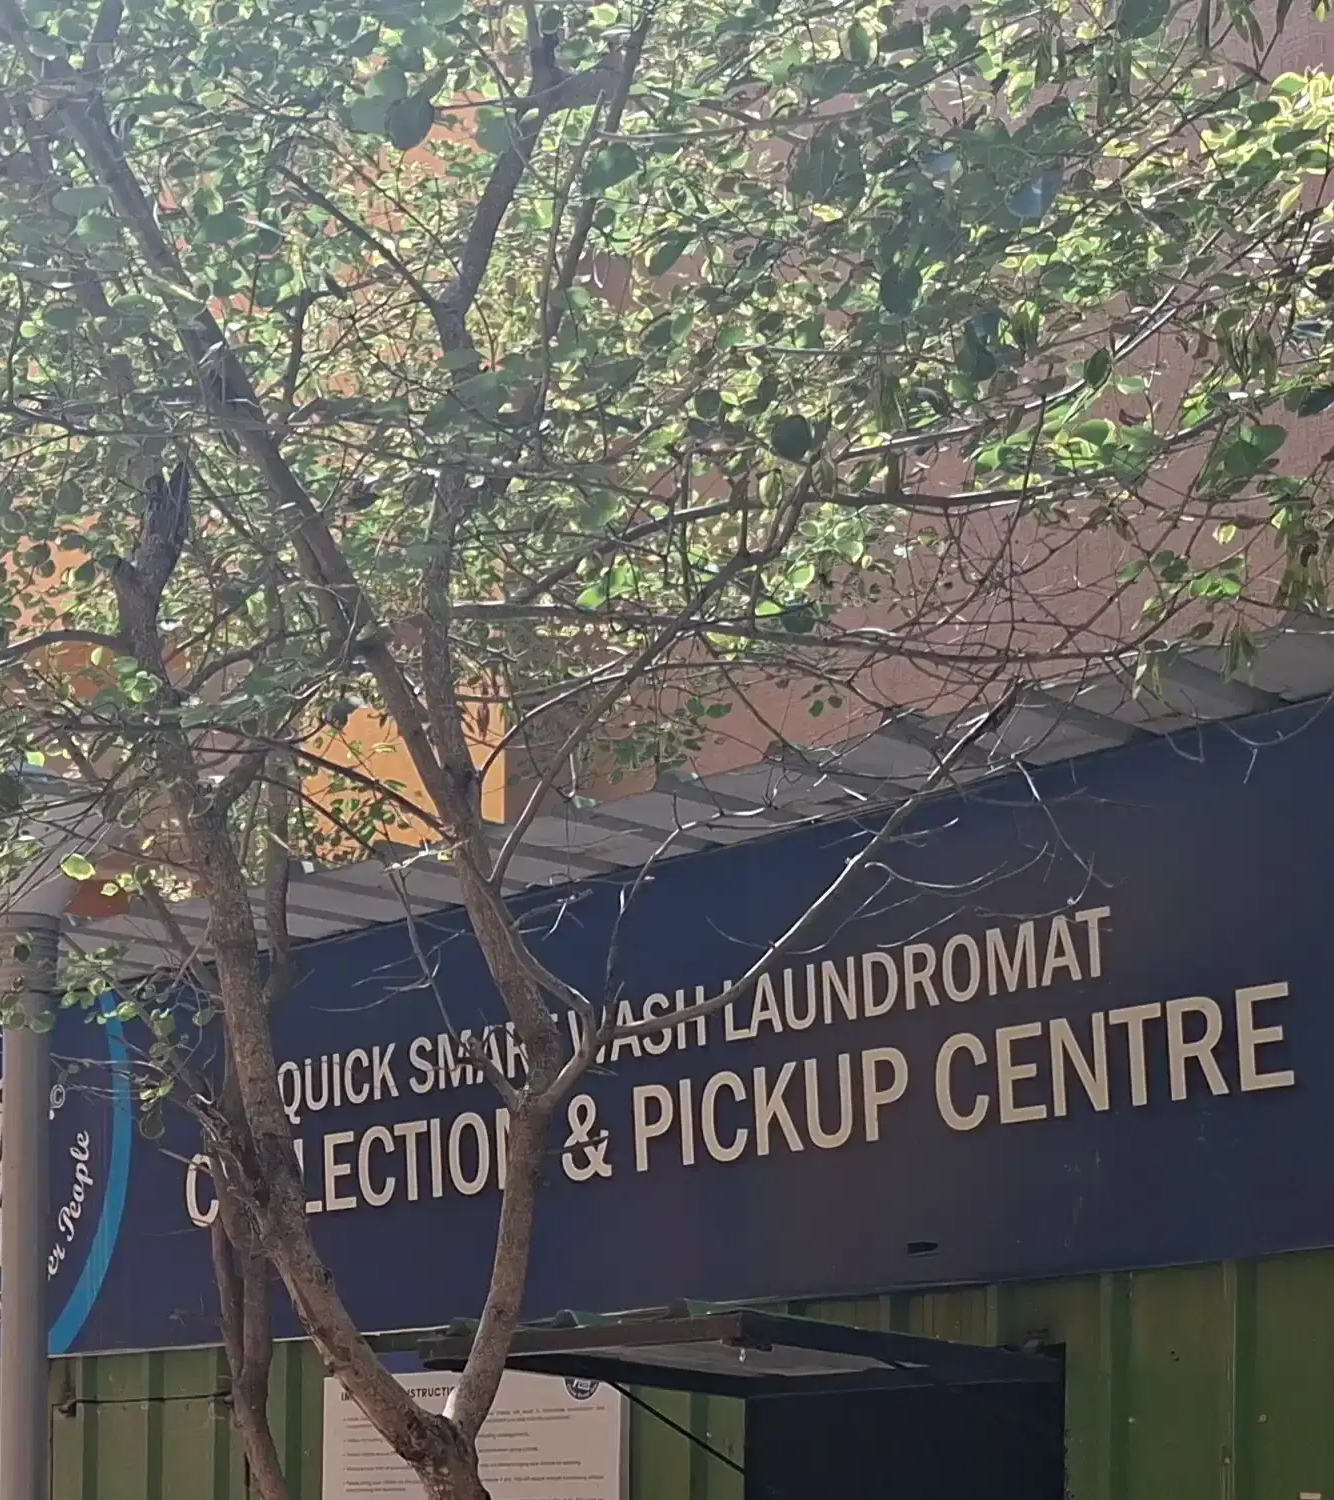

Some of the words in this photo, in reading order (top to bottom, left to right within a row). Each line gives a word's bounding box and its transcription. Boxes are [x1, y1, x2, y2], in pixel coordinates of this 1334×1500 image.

[278, 1042, 399, 1125] QUICK
[408, 1012, 559, 1095] SMAR
[722, 905, 1112, 1042] LAUNDROMAT
[563, 1094, 612, 1182] &
[634, 1047, 909, 1173] PICKUP
[935, 981, 1295, 1132] CENTRE
[58, 1129, 95, 1242] People
